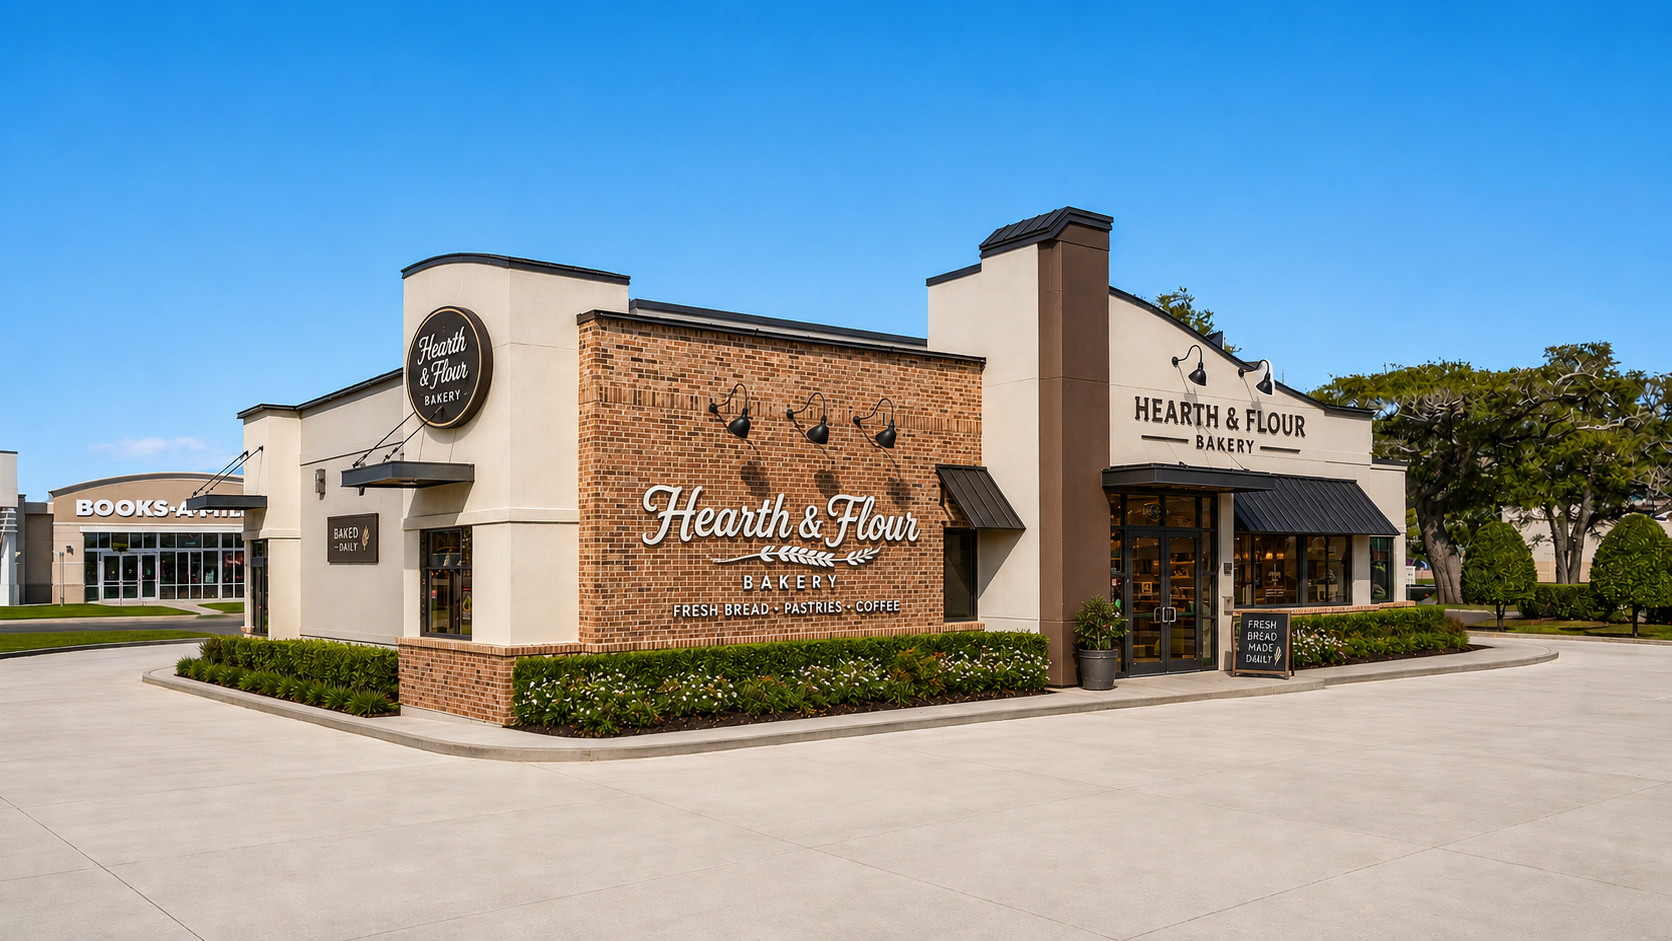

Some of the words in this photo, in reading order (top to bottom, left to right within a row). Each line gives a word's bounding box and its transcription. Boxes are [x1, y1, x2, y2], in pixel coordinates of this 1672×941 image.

[417, 326, 467, 365] Hearth
[420, 367, 429, 387] &
[429, 358, 469, 390] Flour
[424, 389, 461, 406] BAKERY
[1134, 395, 1220, 429] HEARTH
[1226, 406, 1240, 431] &
[1245, 409, 1306, 438] FLOUR
[1195, 434, 1255, 454] BAKERY
[641, 484, 794, 546] Hearth
[798, 505, 823, 539] &
[825, 494, 921, 548] Flour
[333, 526, 359, 540] BAKED
[743, 574, 838, 590] BAKERY
[673, 604, 719, 618] FRESH
[724, 602, 770, 616] BREAD
[784, 600, 843, 615] PASTRIES
[855, 599, 900, 613] COFFEE
[1248, 619, 1277, 629] FRESH
[1247, 631, 1278, 642] BREAD
[1248, 643, 1274, 653] MADE
